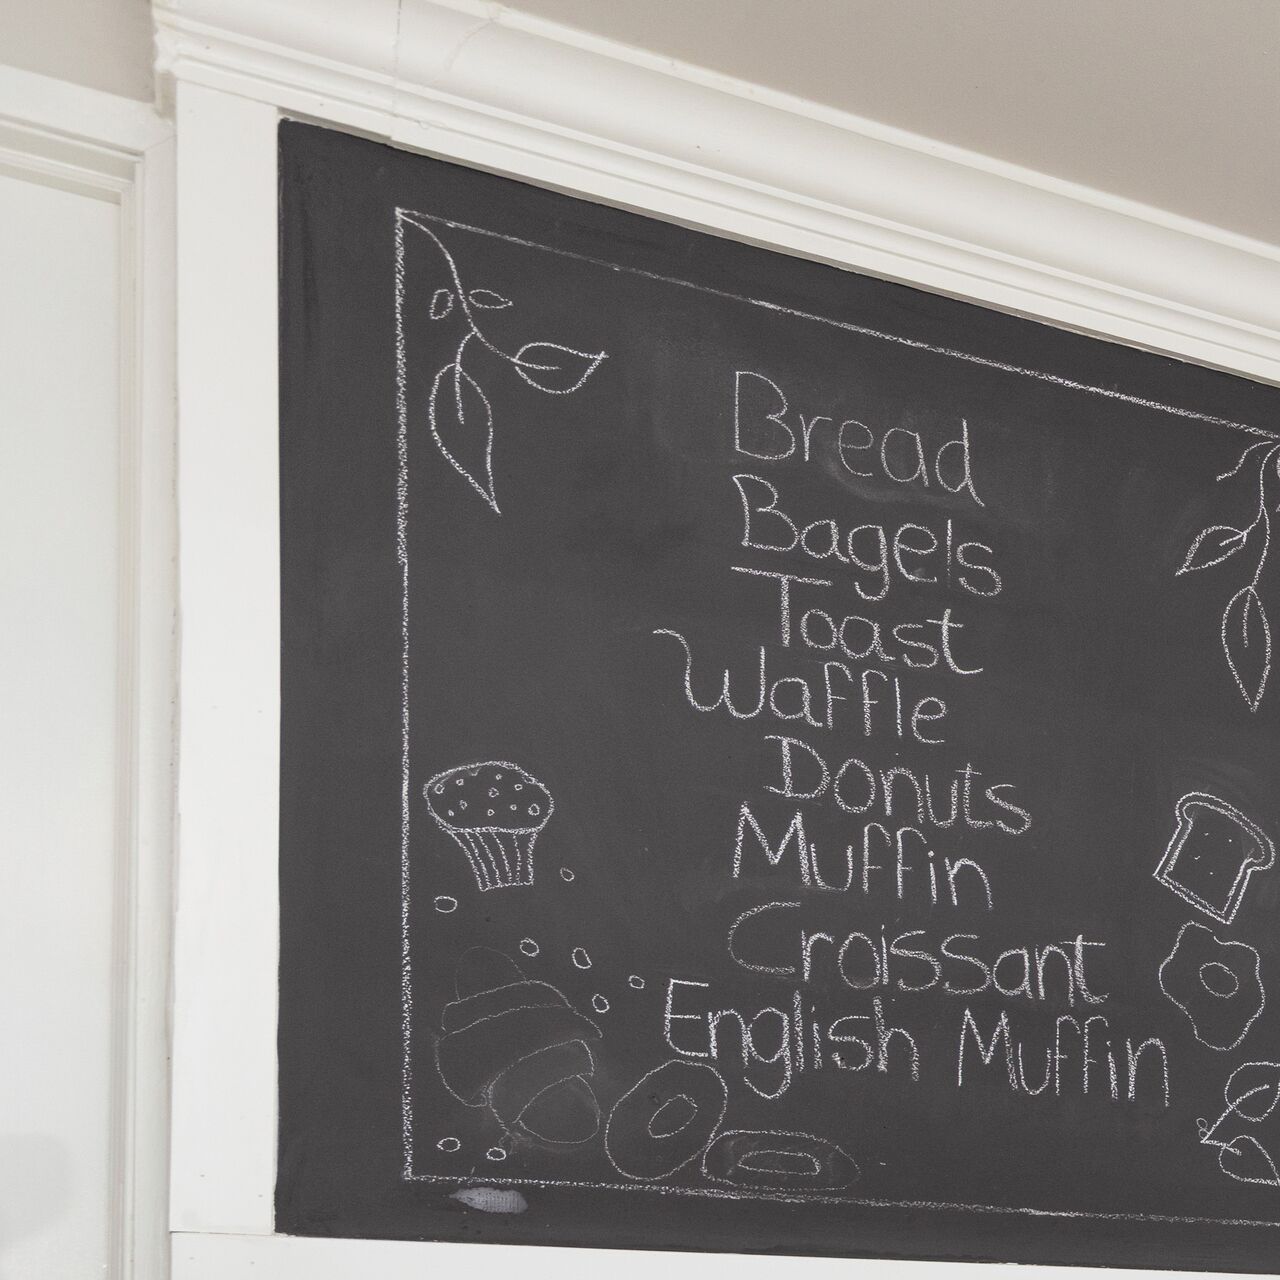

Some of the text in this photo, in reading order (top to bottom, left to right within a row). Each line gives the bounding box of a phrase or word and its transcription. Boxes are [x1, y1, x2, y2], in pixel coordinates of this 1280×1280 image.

[736, 372, 985, 507] Bread
[732, 475, 1002, 602] Bagels
[731, 567, 984, 675] Toast
[653, 630, 948, 744] Waffle
[764, 736, 1032, 835] Donuts
[733, 802, 994, 910] Muffin
[728, 902, 1109, 1007] Croissant
[664, 978, 1170, 1107] English Muffin
